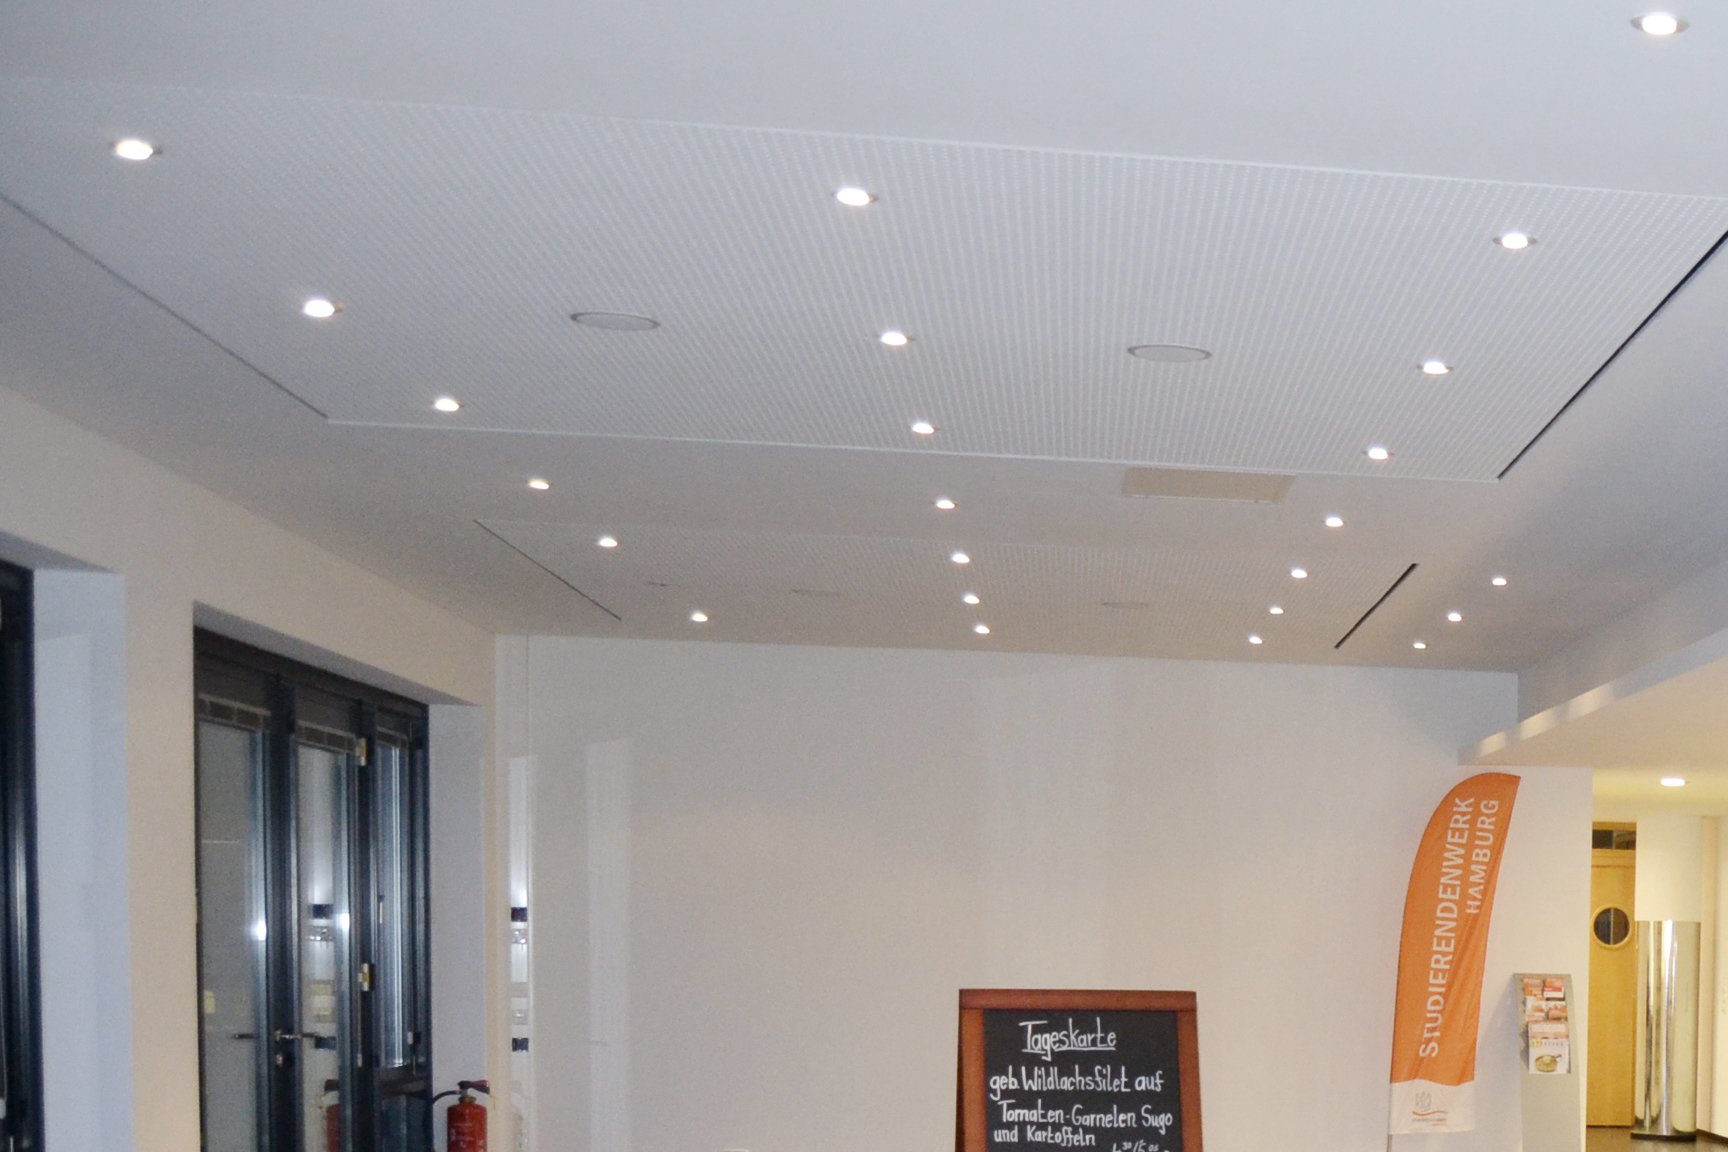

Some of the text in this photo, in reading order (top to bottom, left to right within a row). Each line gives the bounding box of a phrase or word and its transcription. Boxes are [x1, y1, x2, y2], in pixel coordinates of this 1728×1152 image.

[1466, 799, 1499, 915] HAMBURG
[1419, 797, 1475, 1058] STUDIERENDENWERK
[1019, 1017, 1116, 1061] Tageskarte
[1021, 1064, 1131, 1093] Wildlachsfilet
[1134, 1070, 1164, 1092] auf
[994, 1126, 1095, 1147] und Kartoffeln
[1141, 1105, 1173, 1135] Sugo
